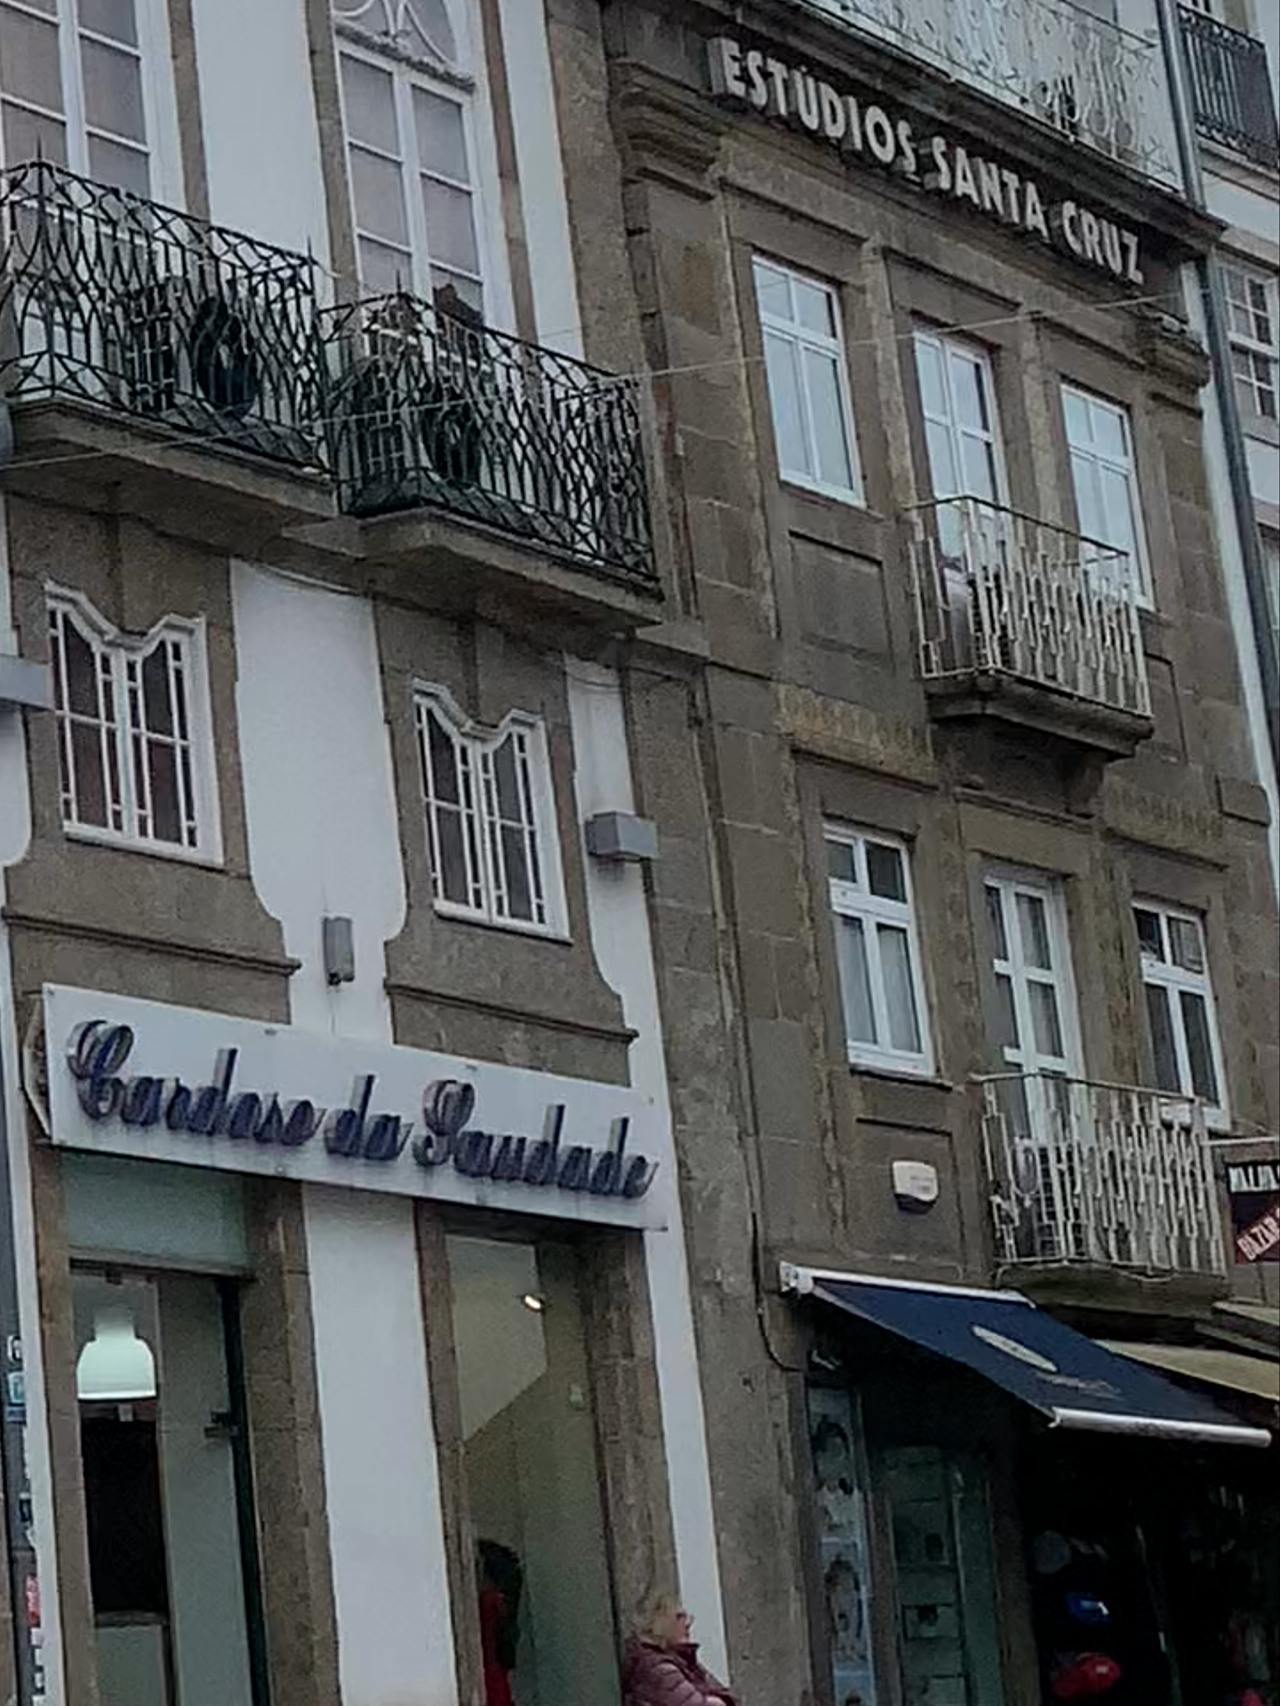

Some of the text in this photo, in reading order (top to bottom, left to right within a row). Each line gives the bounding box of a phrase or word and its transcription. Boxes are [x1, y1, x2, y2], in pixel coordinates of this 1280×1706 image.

[929, 136, 1050, 242] SANTA
[1061, 200, 1144, 285] CRUZ
[66, 1020, 660, 1199] Cardoso da Saudade
